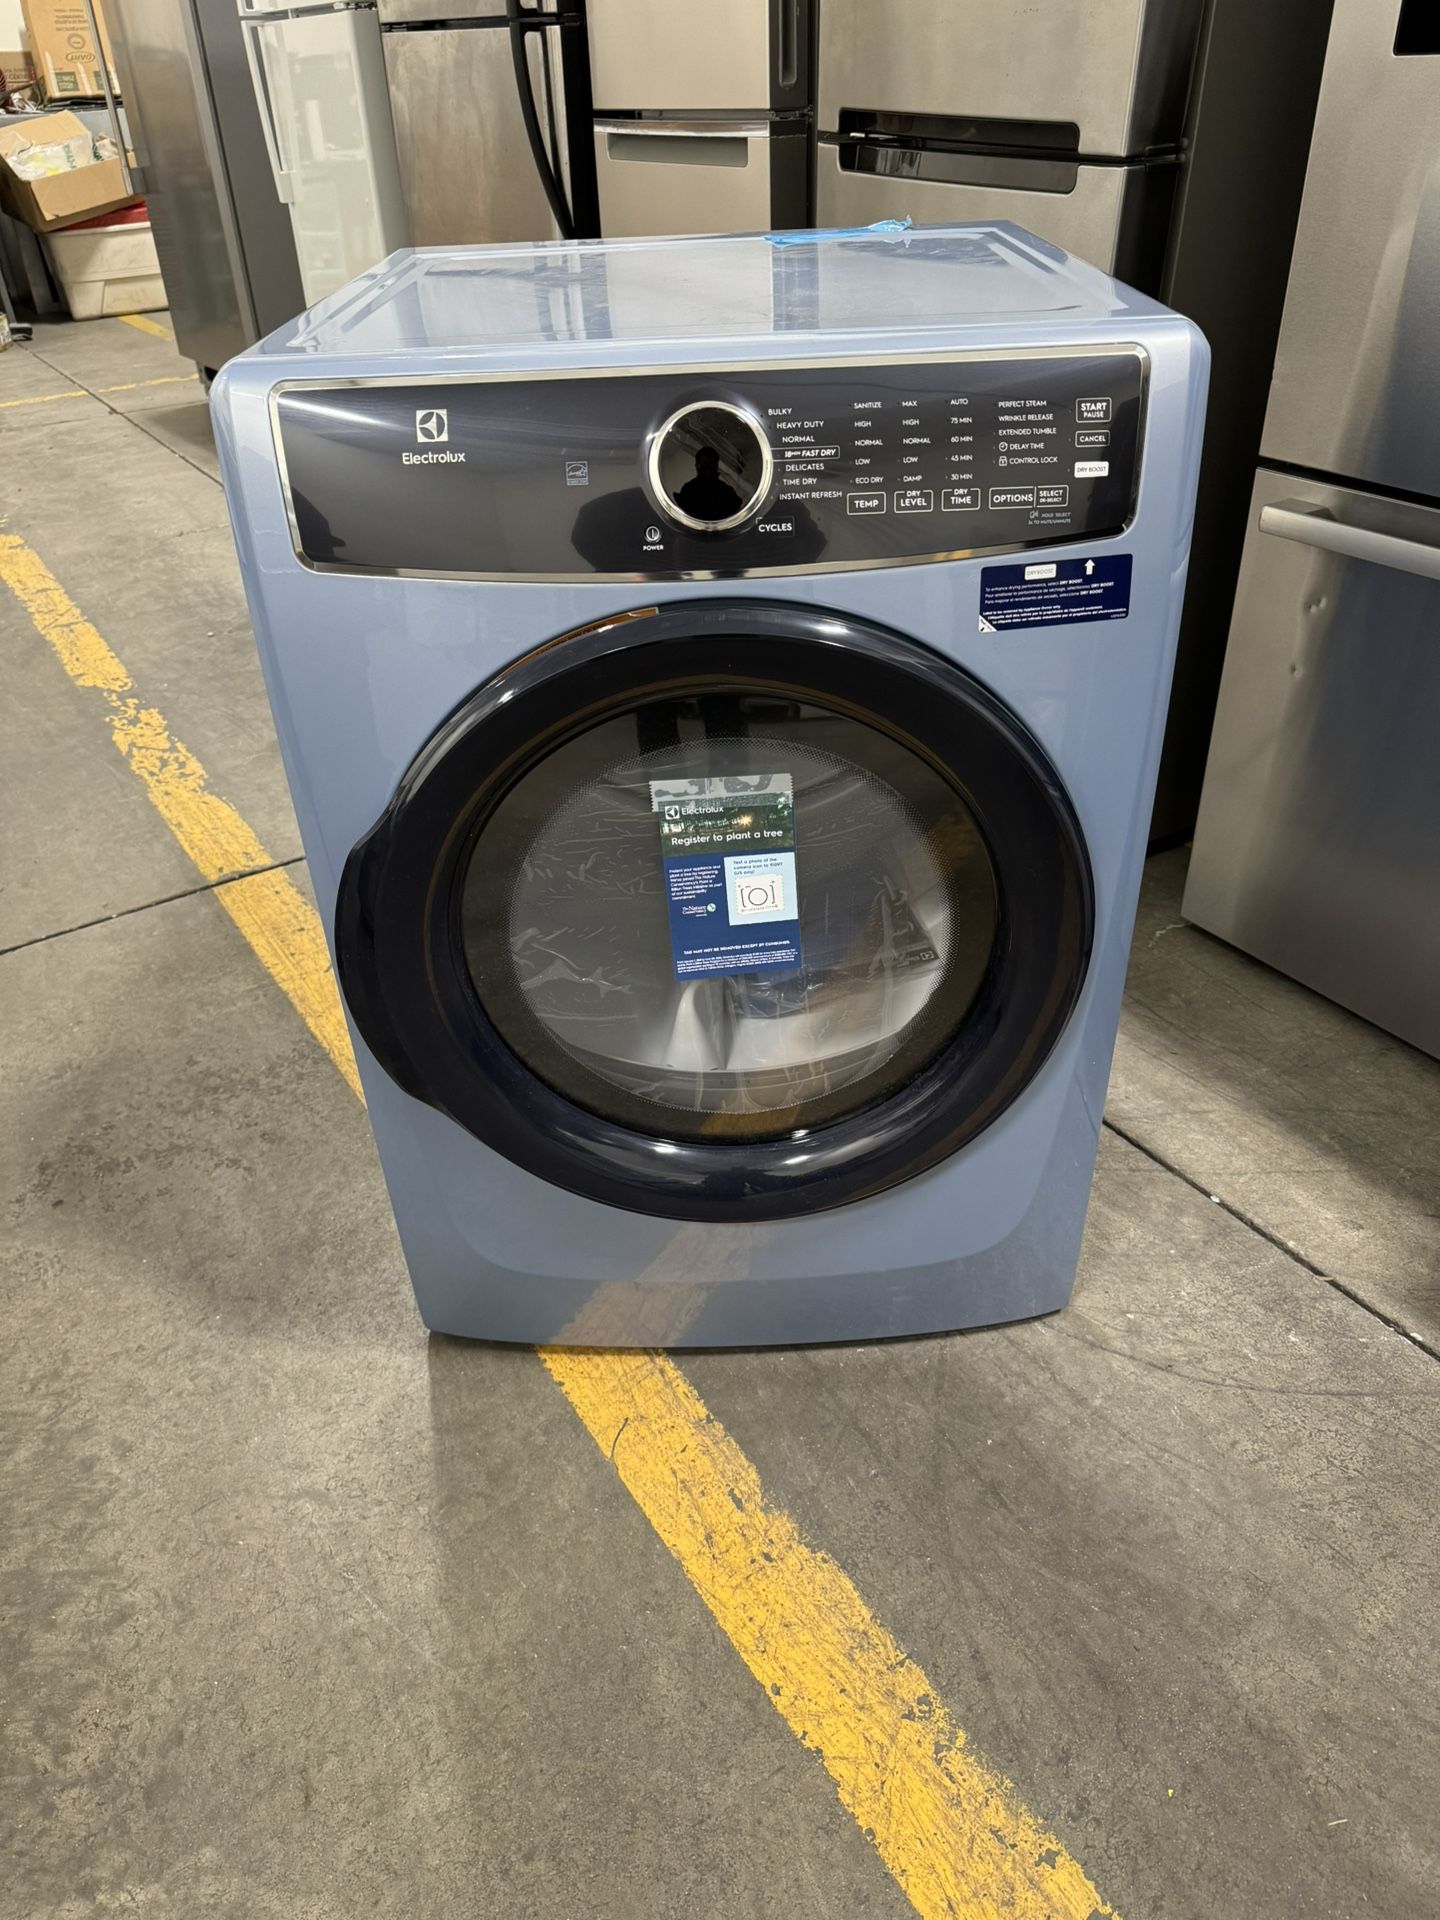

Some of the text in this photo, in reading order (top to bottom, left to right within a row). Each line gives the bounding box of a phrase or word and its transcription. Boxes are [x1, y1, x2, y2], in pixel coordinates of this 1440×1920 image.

[1081, 402, 1107, 411] START
[768, 408, 793, 416] BULKY
[902, 418, 919, 426] HIGH
[1032, 427, 1057, 435] TUMBLE
[1079, 435, 1106, 443] CANCEL
[402, 450, 466, 465] Electrolux
[801, 449, 820, 457] FAST
[1009, 457, 1040, 465] CONTROL
[785, 463, 825, 472] DELICATES
[783, 477, 817, 486] TIME DRY
[871, 476, 884, 484] DRY
[779, 491, 843, 500] INSTANT REFRESH
[950, 496, 972, 504] TIME
[993, 494, 1033, 503] OPTIONS
[854, 500, 879, 509] TEMP
[900, 498, 927, 507] LEVEL
[758, 523, 793, 532] CYCLES
[681, 806, 724, 816] Electrolux
[671, 836, 710, 847] Register
[713, 834, 723, 842] to
[726, 831, 751, 843] plant
[763, 829, 784, 838] tree
